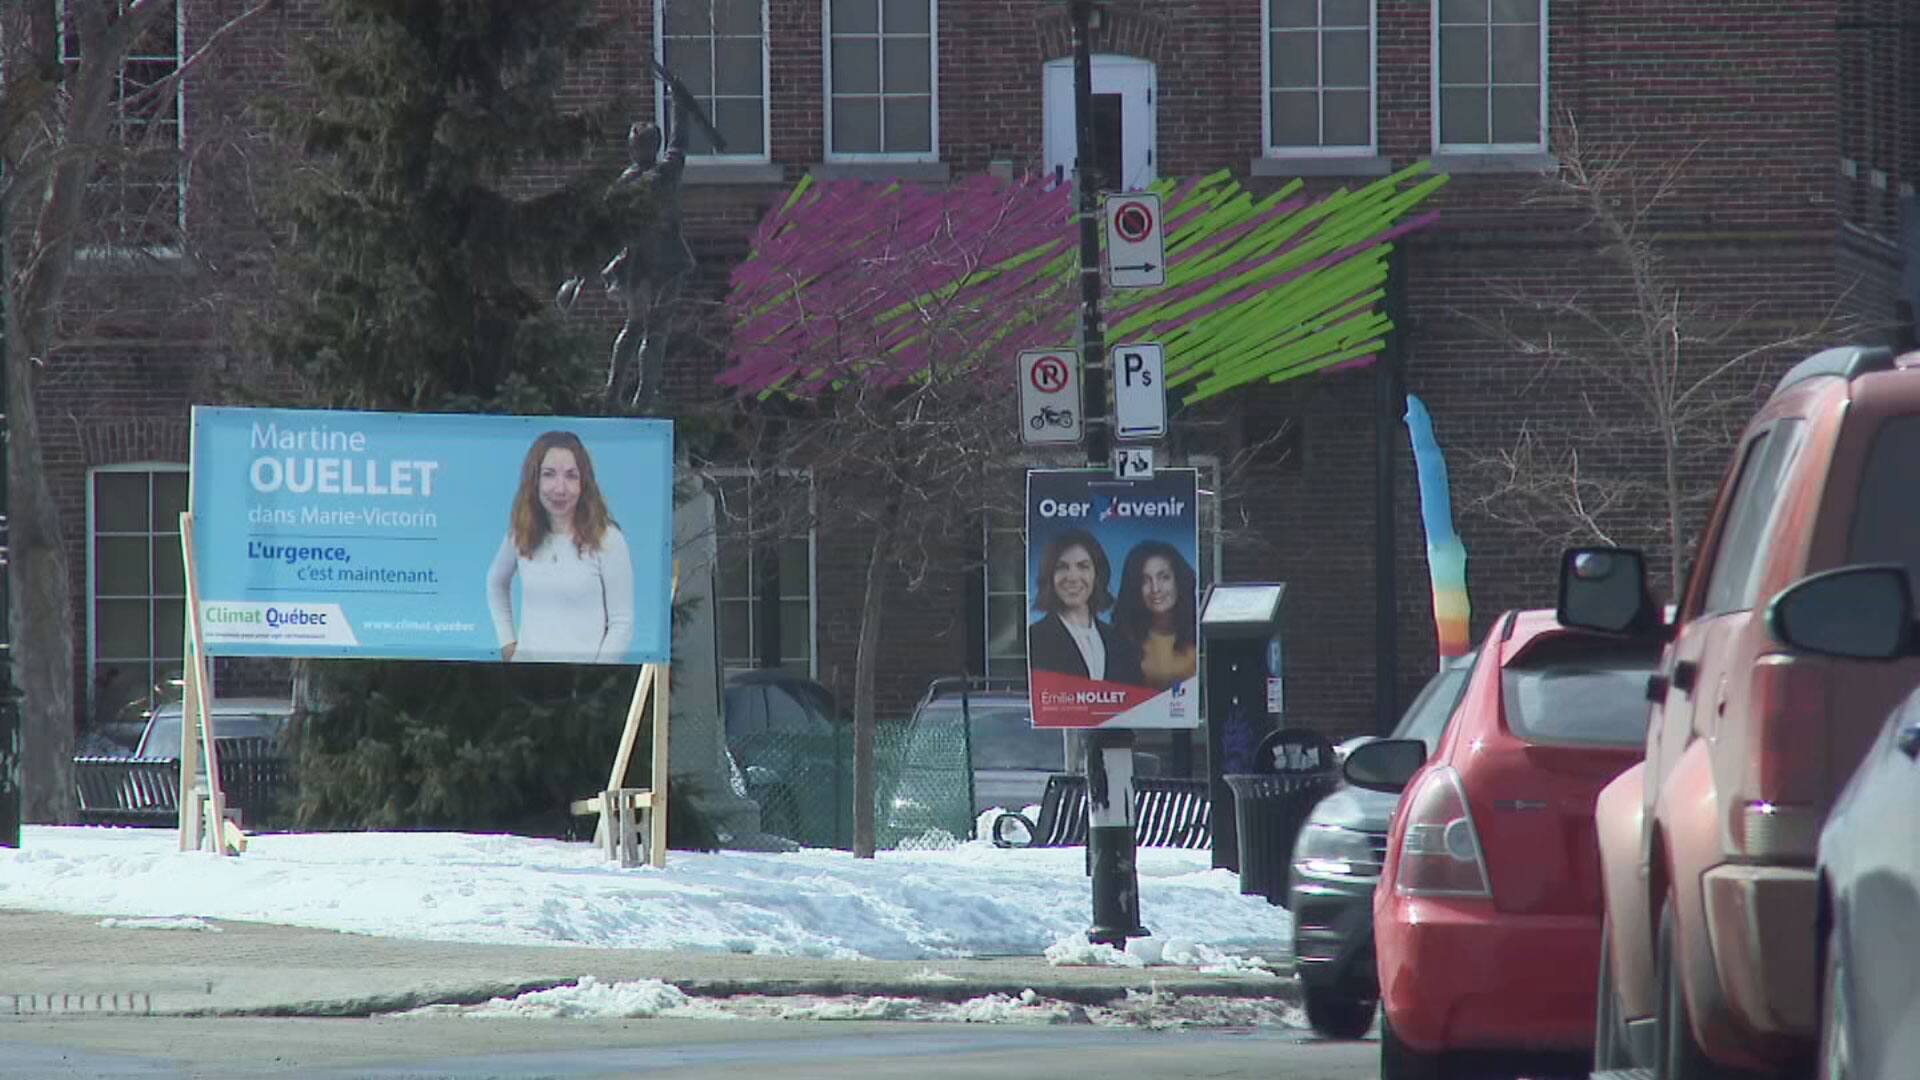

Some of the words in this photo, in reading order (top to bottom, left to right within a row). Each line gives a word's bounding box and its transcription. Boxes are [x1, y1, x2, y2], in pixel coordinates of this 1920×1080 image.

[252, 423, 366, 451] Martine
[251, 456, 439, 496] OUELLET
[249, 504, 297, 524] dans
[301, 506, 437, 528] Marie-Victorin
[1039, 499, 1091, 518] Oser
[248, 542, 351, 564] L'urgence,
[297, 565, 333, 582] c'est
[338, 567, 439, 584] maintenant.
[205, 607, 262, 623] Climat
[265, 607, 327, 627] Québec
[1041, 688, 1075, 705] Émilie
[1076, 691, 1127, 704] NOLLET
